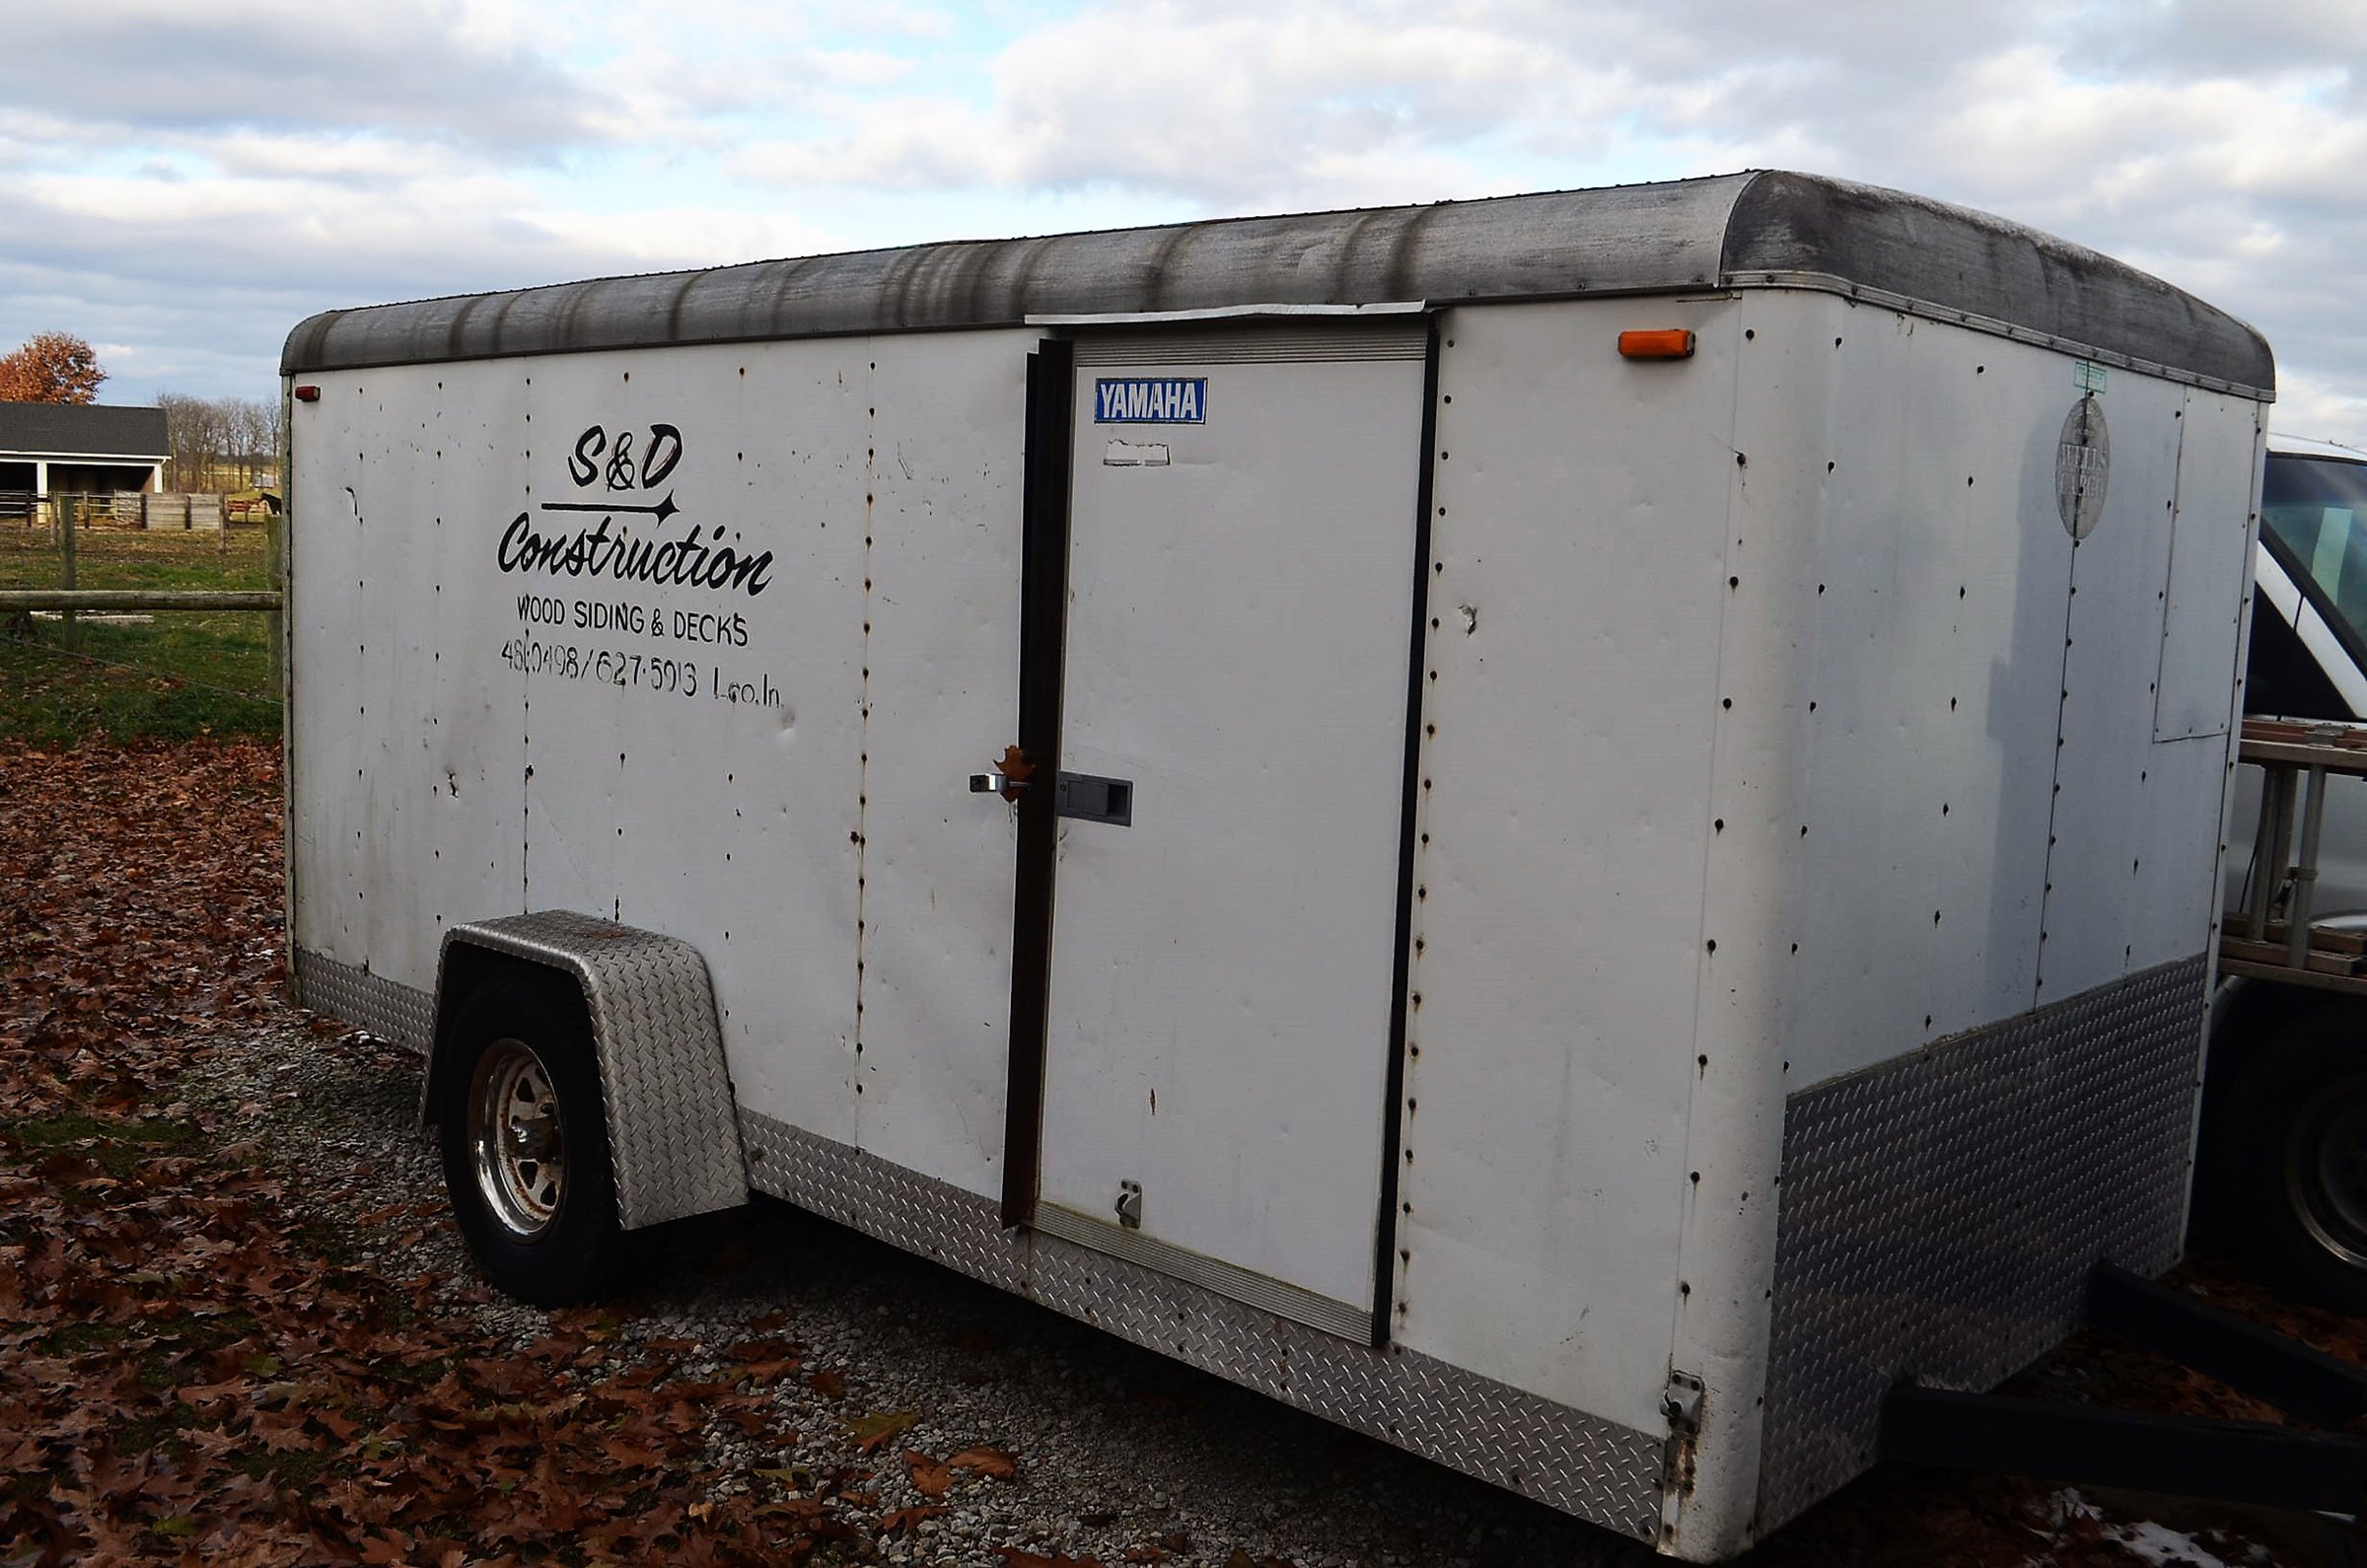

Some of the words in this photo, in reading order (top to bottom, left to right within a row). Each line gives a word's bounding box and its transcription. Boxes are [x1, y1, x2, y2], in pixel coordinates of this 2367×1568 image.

[1100, 382, 1197, 418] YAMAHA
[567, 424, 682, 492] S&D
[497, 511, 773, 597] Construction
[517, 594, 565, 624] WOOD
[574, 600, 644, 634] SIDING
[651, 607, 664, 637] &
[674, 609, 749, 647] DECKS
